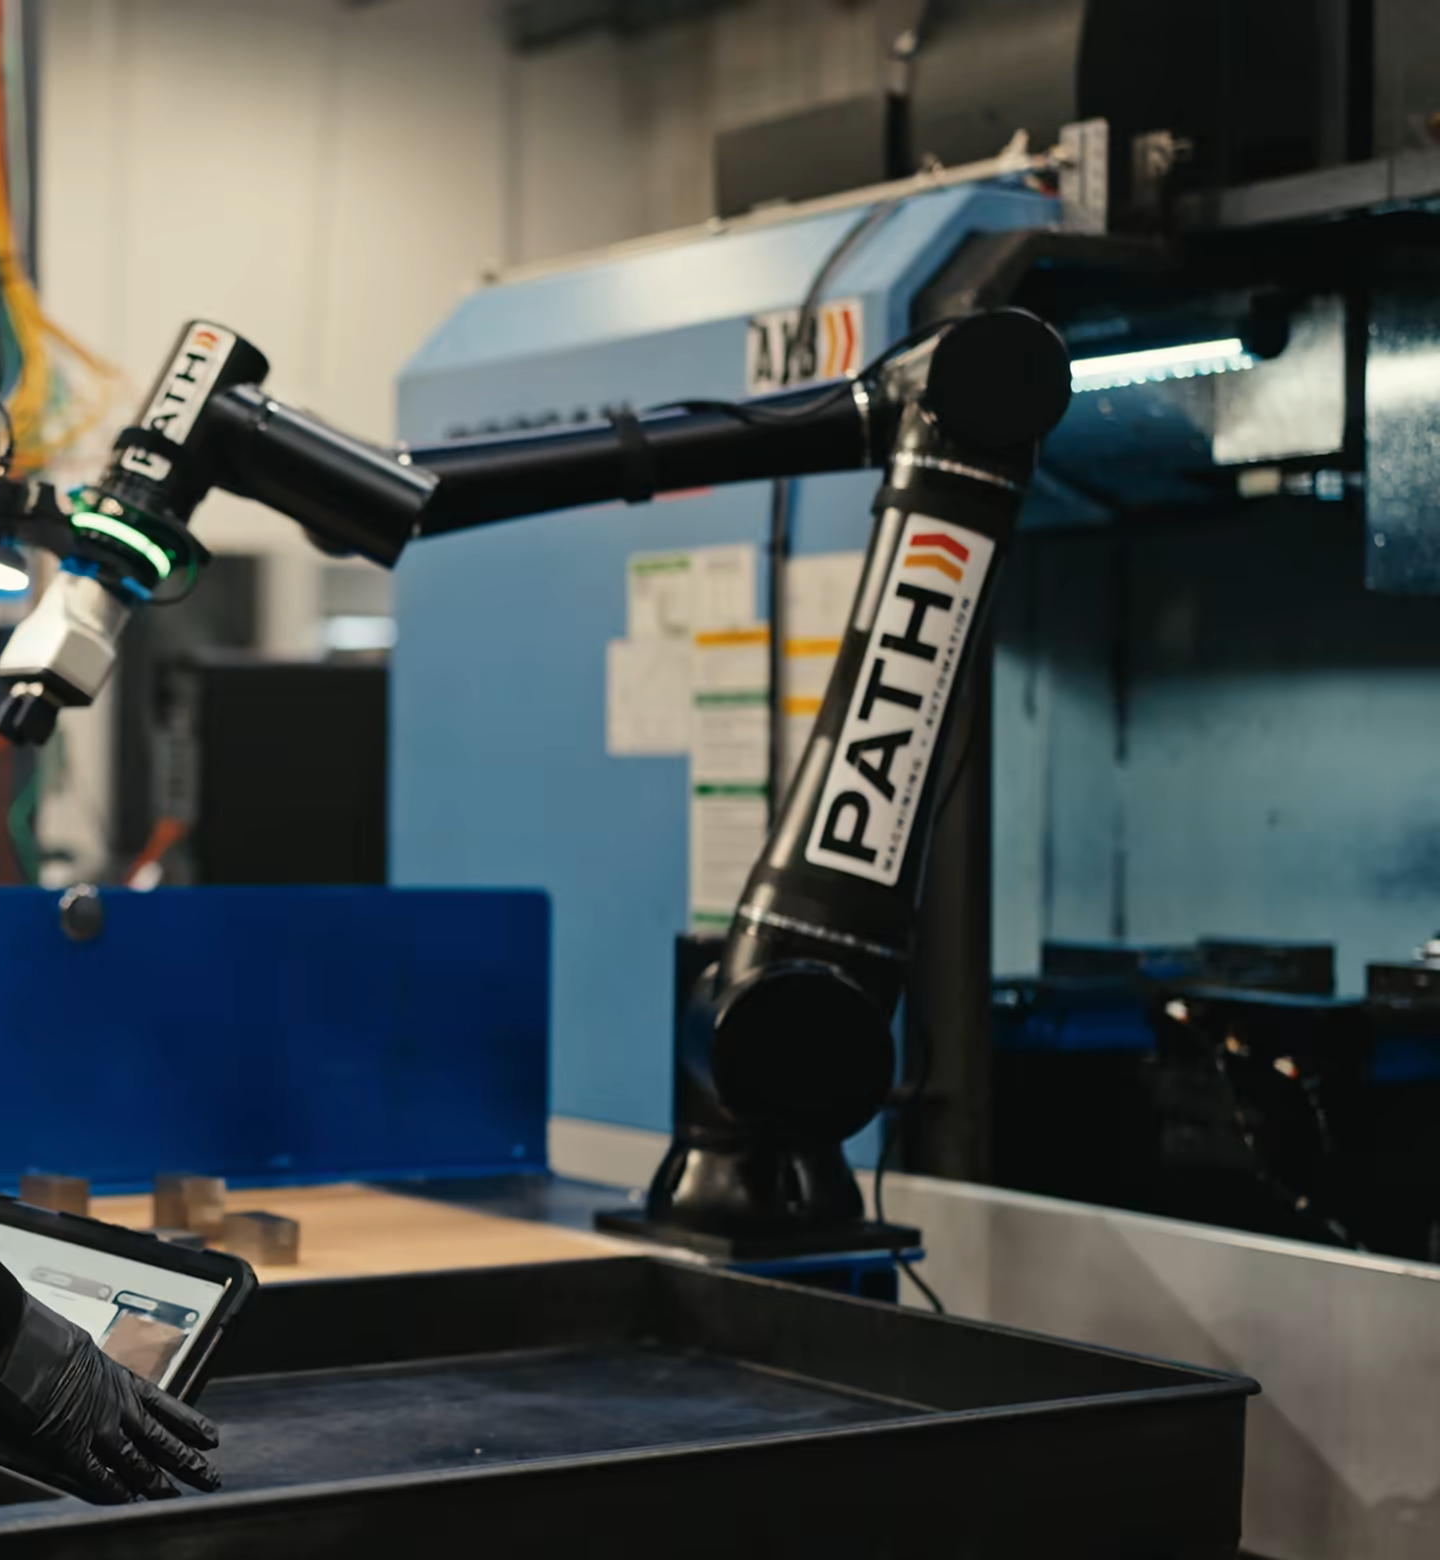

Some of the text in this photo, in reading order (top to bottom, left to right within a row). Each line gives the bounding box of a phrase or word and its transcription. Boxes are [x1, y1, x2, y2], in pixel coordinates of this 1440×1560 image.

[819, 582, 954, 864] PATH
[883, 597, 971, 872] MACHINING AUTOMATION
